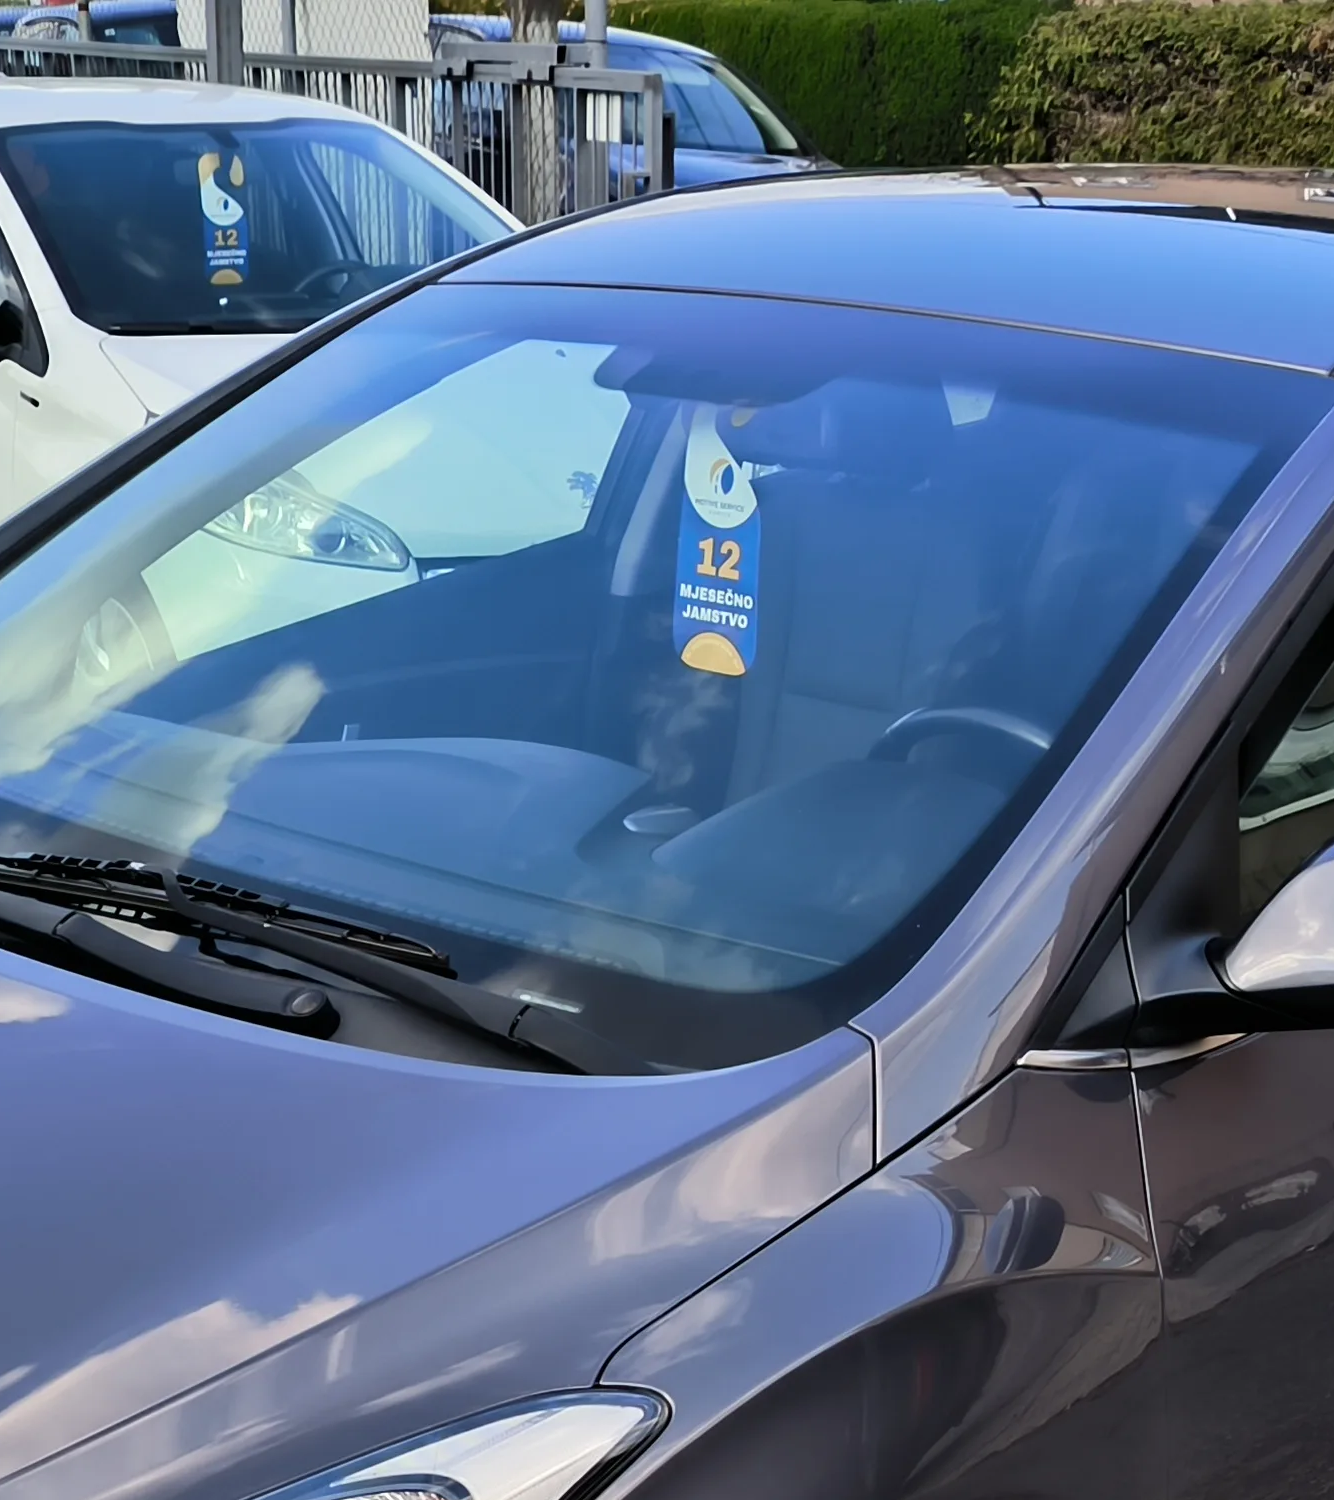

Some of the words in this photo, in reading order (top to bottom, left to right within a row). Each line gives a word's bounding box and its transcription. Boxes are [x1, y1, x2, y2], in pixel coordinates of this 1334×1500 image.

[214, 229, 238, 246] 12
[696, 537, 741, 581] 12
[679, 583, 754, 610] MJESEČNO
[682, 604, 749, 629] JAMSTVO
